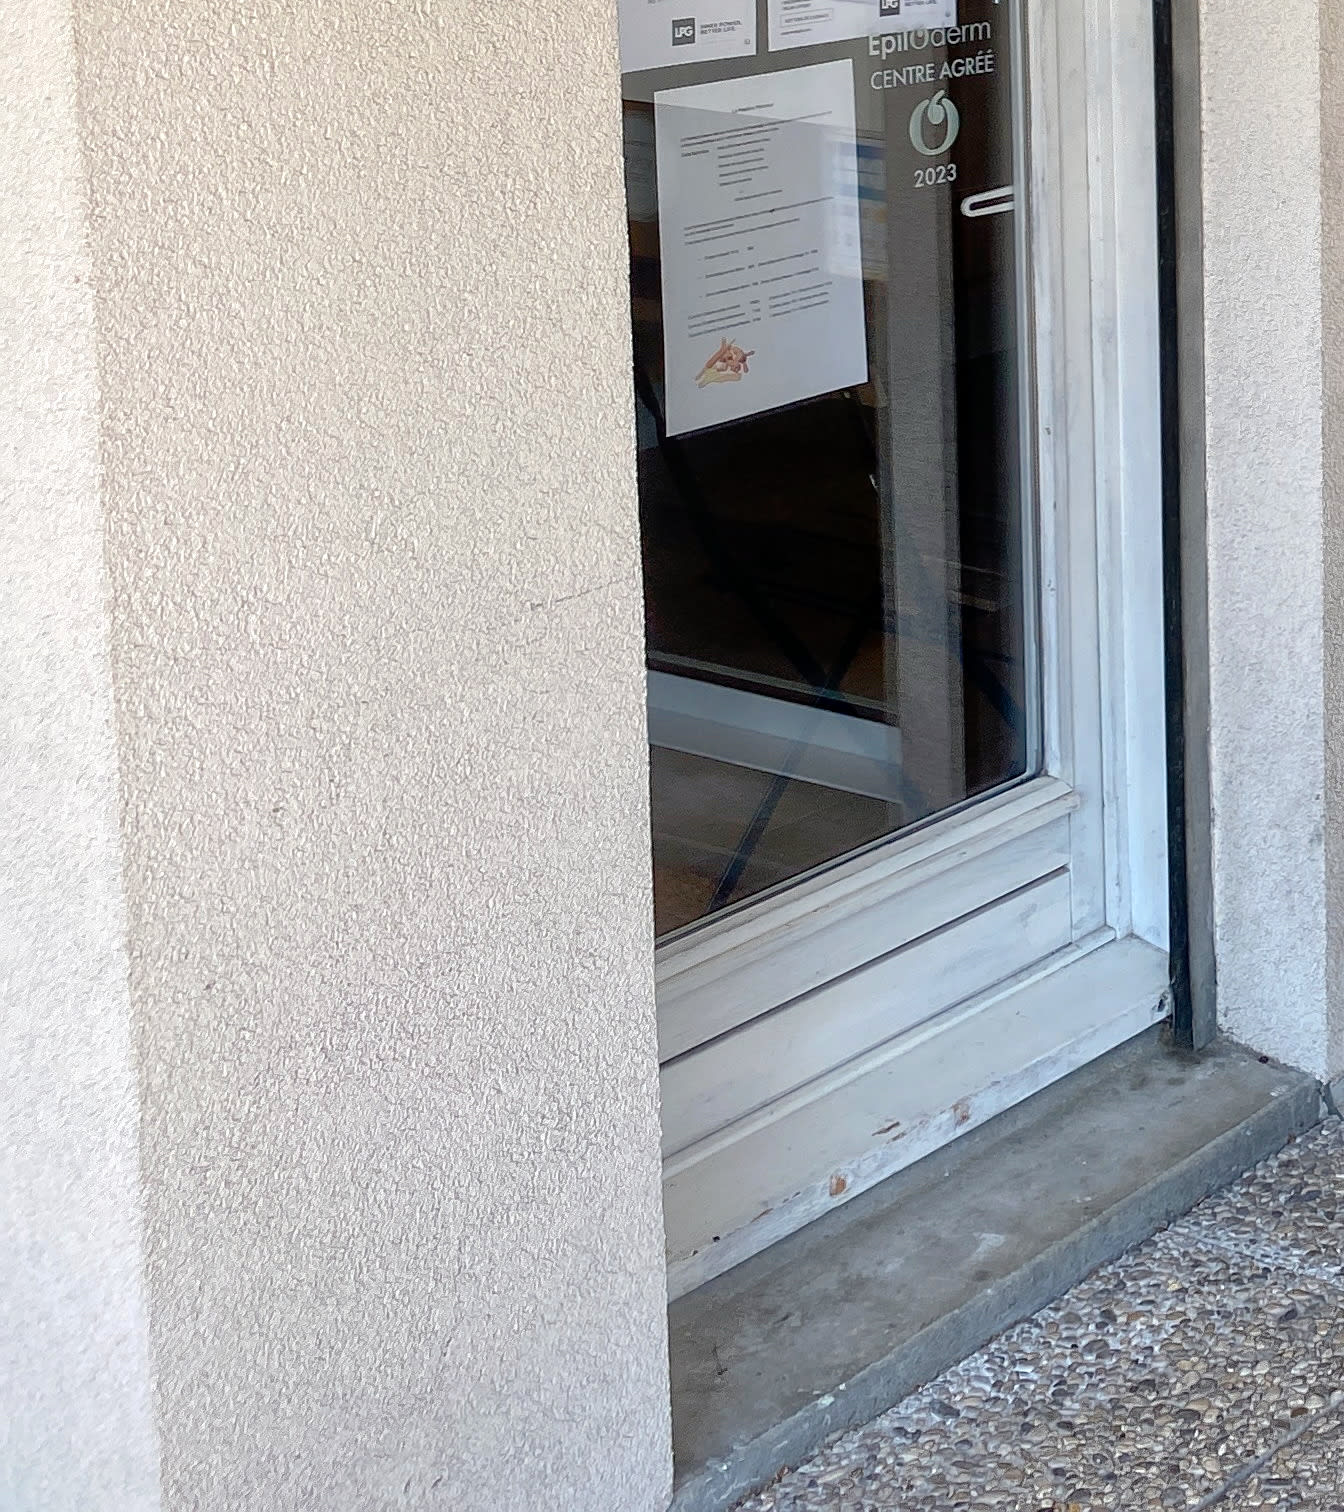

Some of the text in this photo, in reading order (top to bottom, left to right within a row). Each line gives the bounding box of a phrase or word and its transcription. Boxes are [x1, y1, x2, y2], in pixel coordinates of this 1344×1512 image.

[882, 0, 898, 9] LPG
[674, 26, 693, 38] LPG
[870, 51, 996, 91] CENTRE AGRÉÉ
[913, 163, 958, 189] 2023
